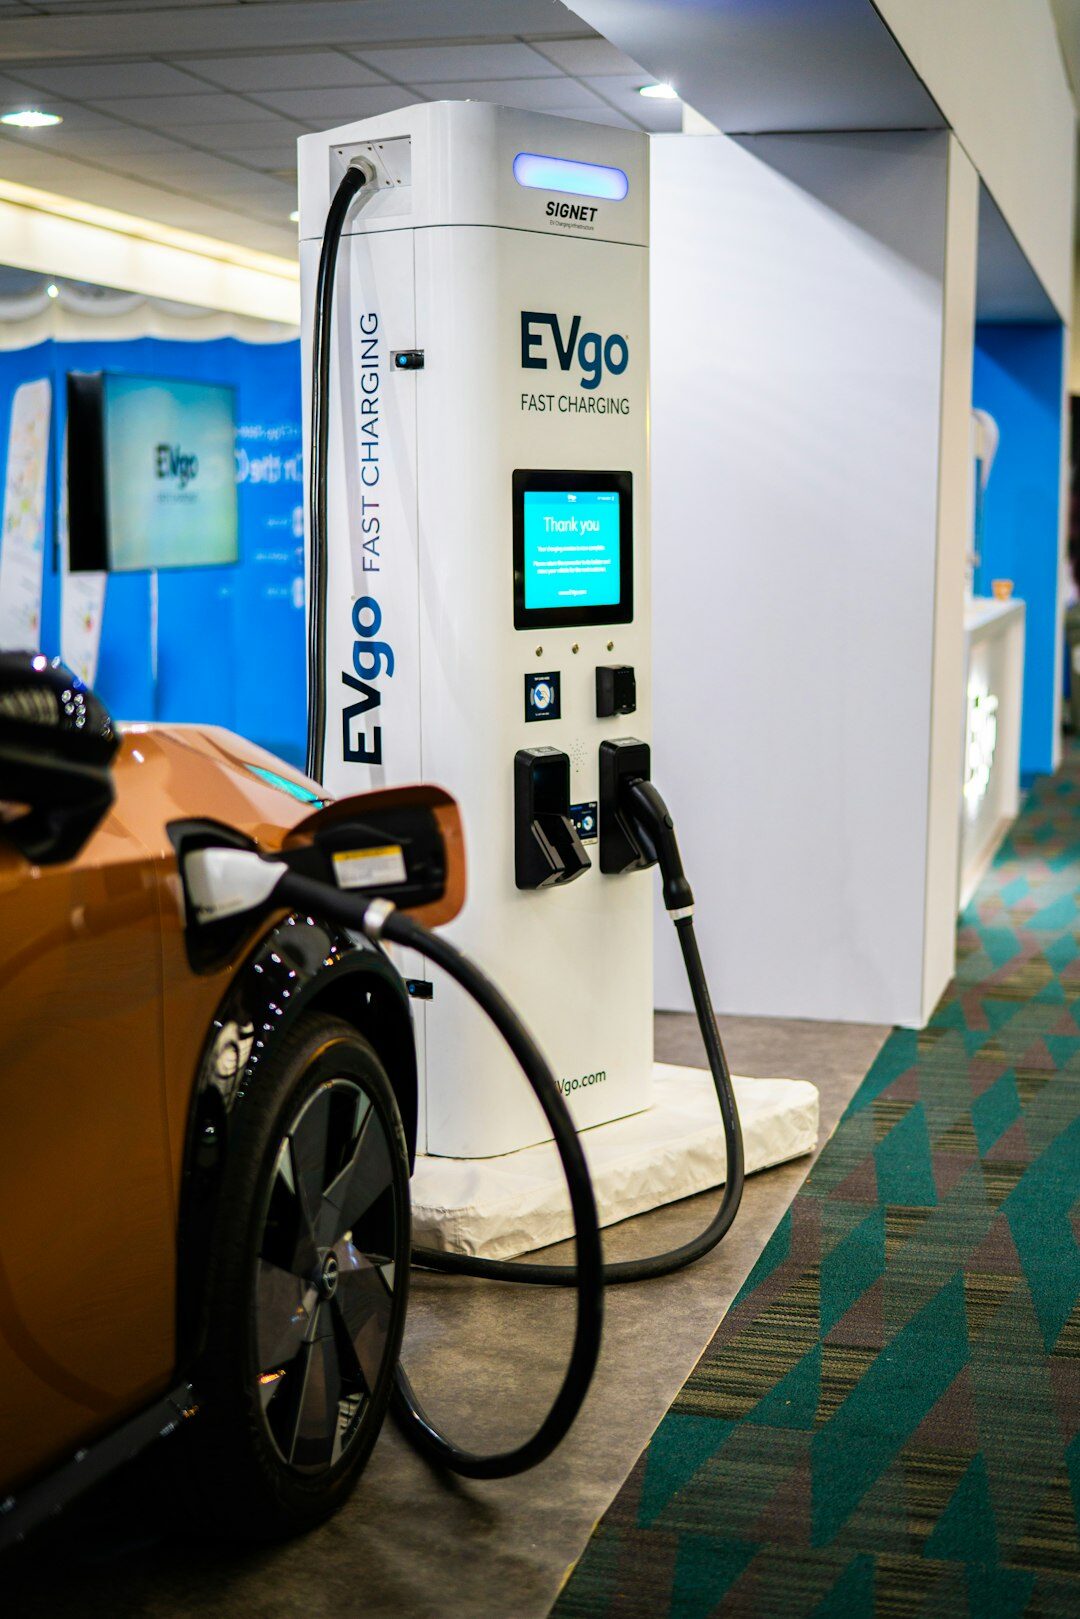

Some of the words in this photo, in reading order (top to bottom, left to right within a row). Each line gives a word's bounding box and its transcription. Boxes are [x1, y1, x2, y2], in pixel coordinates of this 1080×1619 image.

[545, 201, 598, 222] SIGNET
[520, 310, 629, 390] EVgo
[359, 312, 380, 487] CHARGING
[520, 393, 555, 412] FAST
[558, 395, 630, 415] CHARGING
[361, 495, 381, 572] FAST
[543, 516, 578, 533] Thank
[579, 519, 600, 536] you
[341, 595, 395, 765] EVgo
[554, 1070, 607, 1097] Vgo.com
